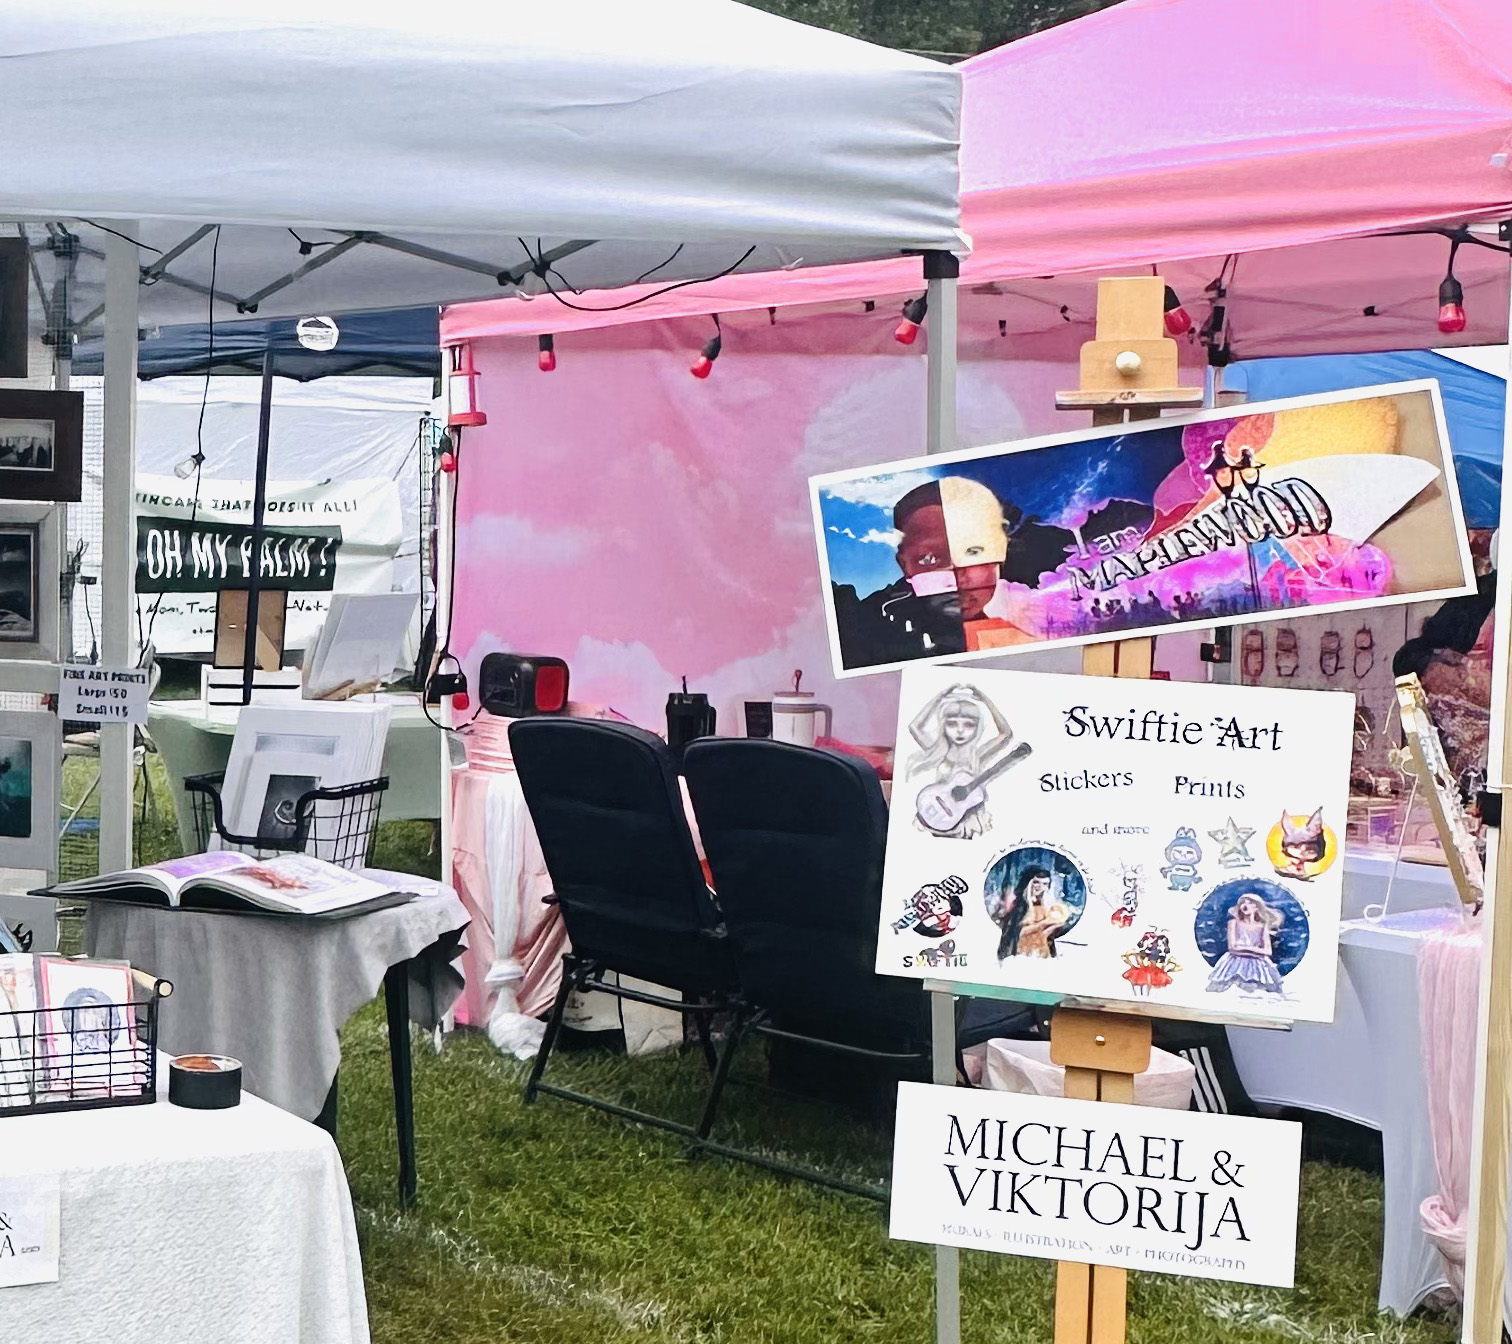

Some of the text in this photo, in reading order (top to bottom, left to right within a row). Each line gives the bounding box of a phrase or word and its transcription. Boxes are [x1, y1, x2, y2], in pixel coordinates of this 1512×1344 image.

[146, 529, 183, 579] OH
[191, 531, 232, 579] MY
[1063, 705, 1284, 751] Swiftie Art
[1039, 769, 1246, 799] Stickers Prints
[1081, 823, 1150, 835] and more
[943, 1113, 1246, 1188] MICHAEL &
[943, 1163, 1251, 1251] VIKTORIJA
